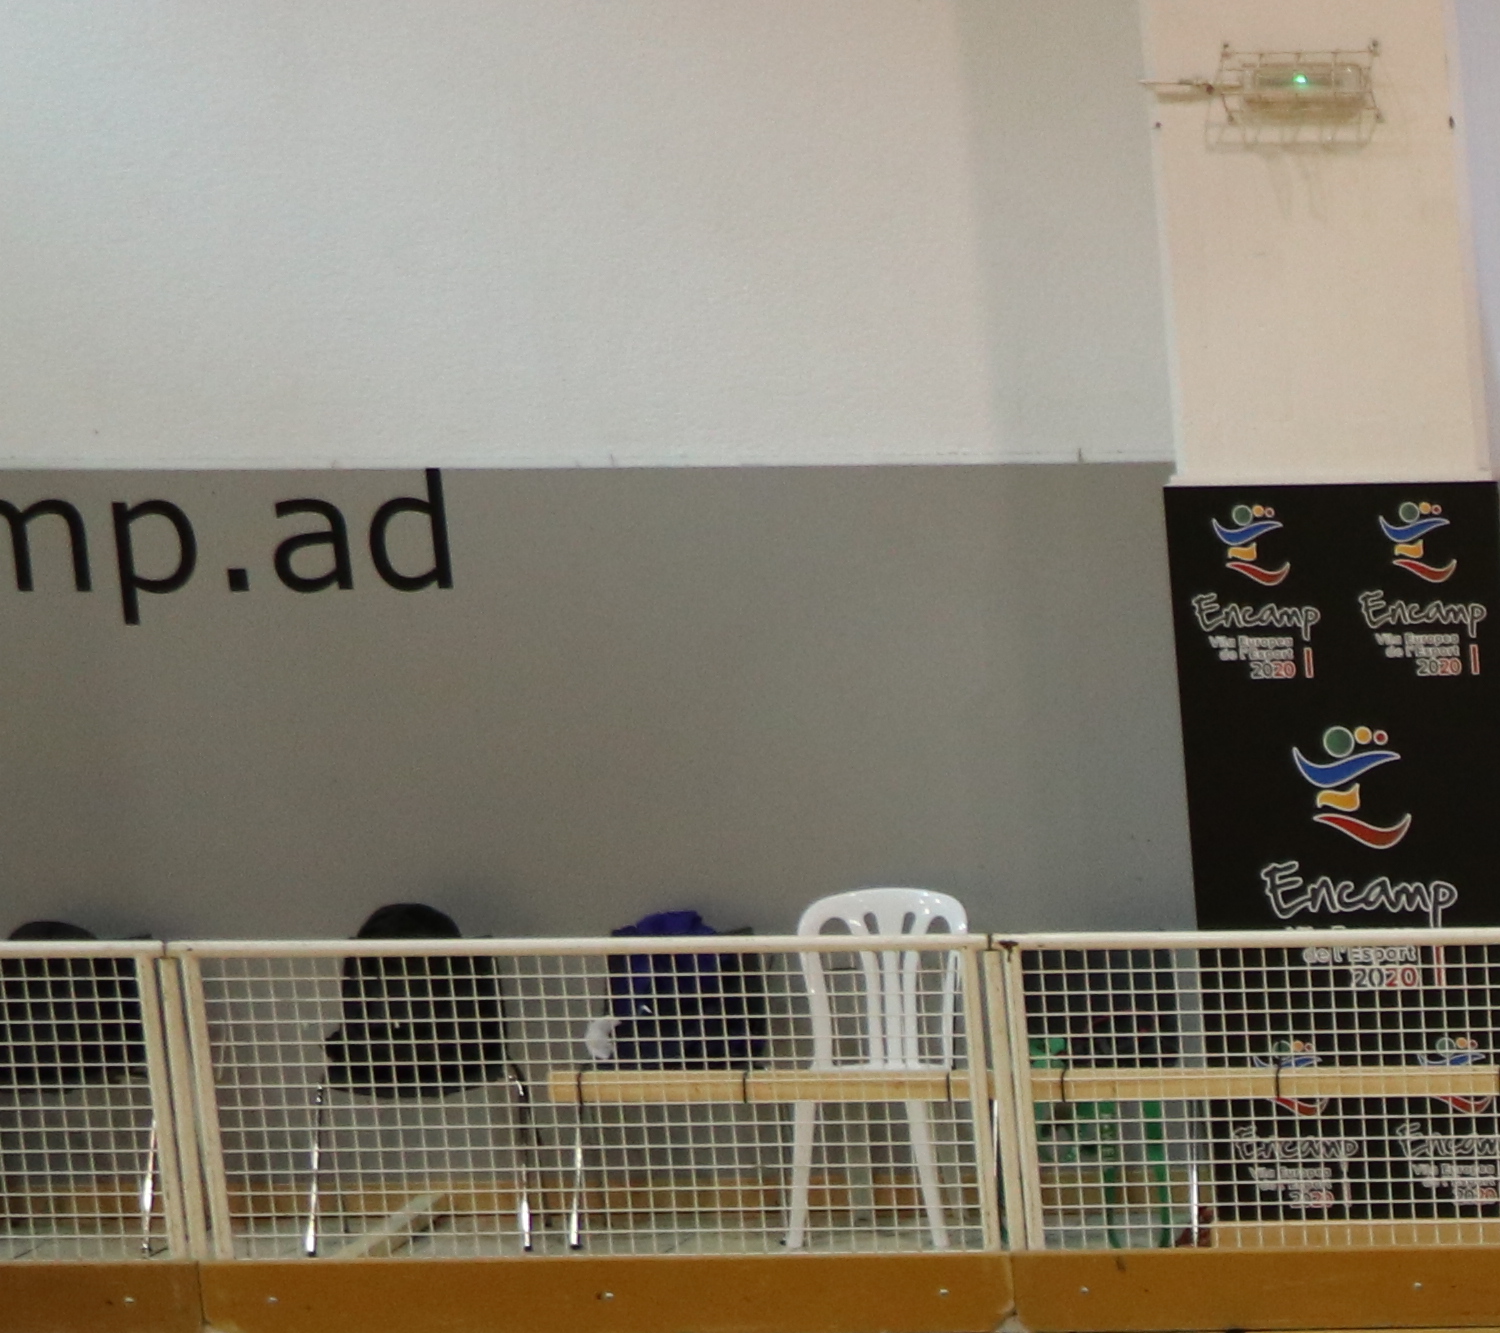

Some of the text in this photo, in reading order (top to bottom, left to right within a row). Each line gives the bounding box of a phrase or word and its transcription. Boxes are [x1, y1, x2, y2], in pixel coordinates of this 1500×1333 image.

[1191, 593, 1321, 642] Encamp
[1357, 589, 1488, 638] Encamp
[1250, 661, 1298, 680] 2020
[1415, 657, 1463, 677] 2020
[1260, 860, 1458, 929] Encamp
[1351, 965, 1421, 989] 2020
